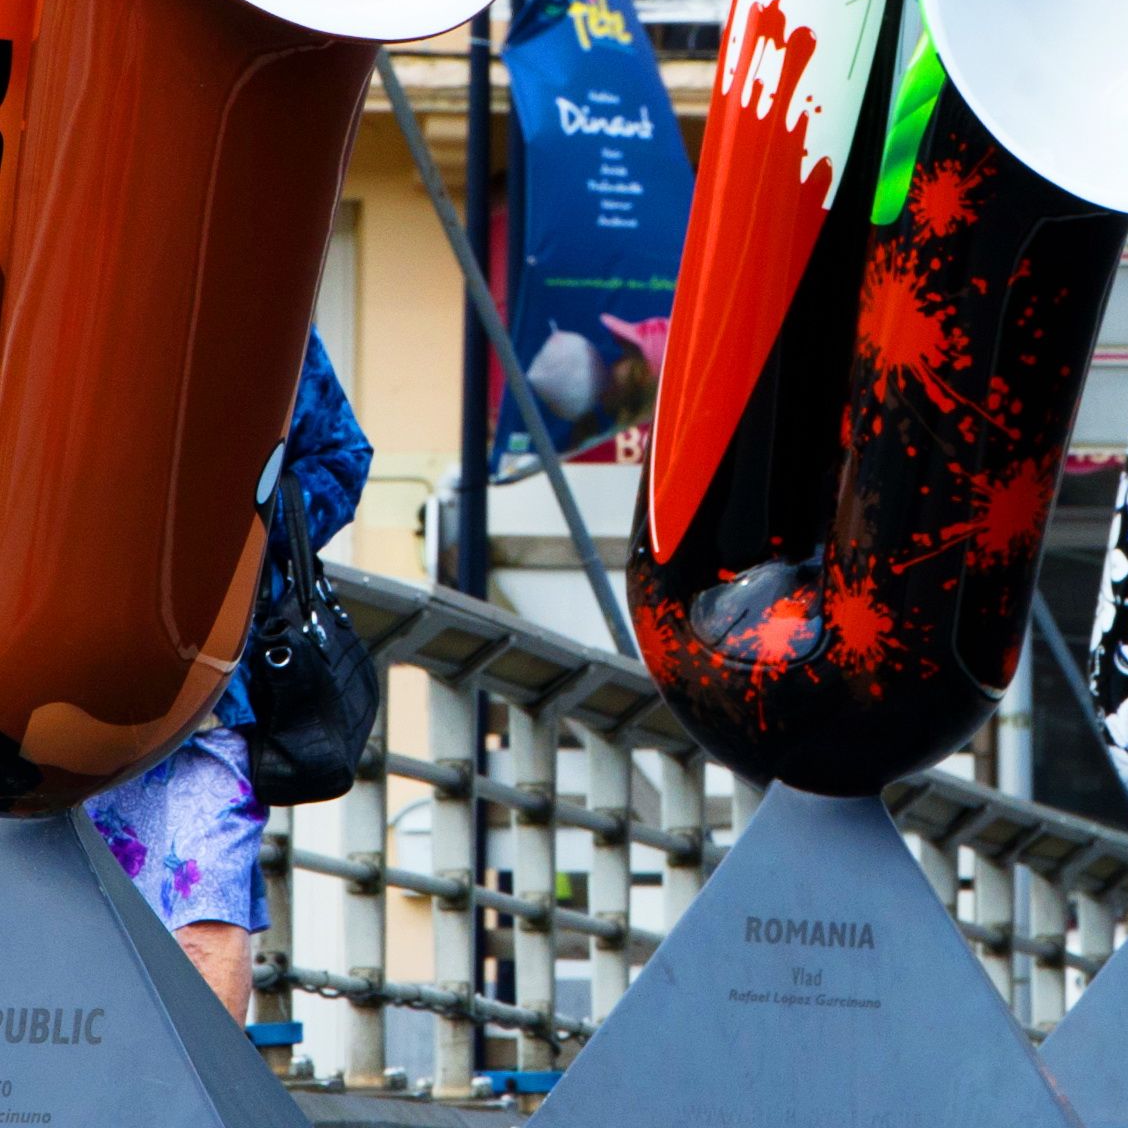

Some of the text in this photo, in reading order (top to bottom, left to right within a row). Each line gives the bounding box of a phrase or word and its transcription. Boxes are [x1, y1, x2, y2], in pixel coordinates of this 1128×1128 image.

[555, 97, 655, 139] Dinant
[744, 915, 876, 949] ROMANIA
[792, 967, 823, 986] Vlad
[728, 989, 771, 1004] Rafael
[773, 992, 812, 1008] Lopez
[0, 1007, 104, 1045] UBLIC
[0, 1108, 51, 1124] inuno
